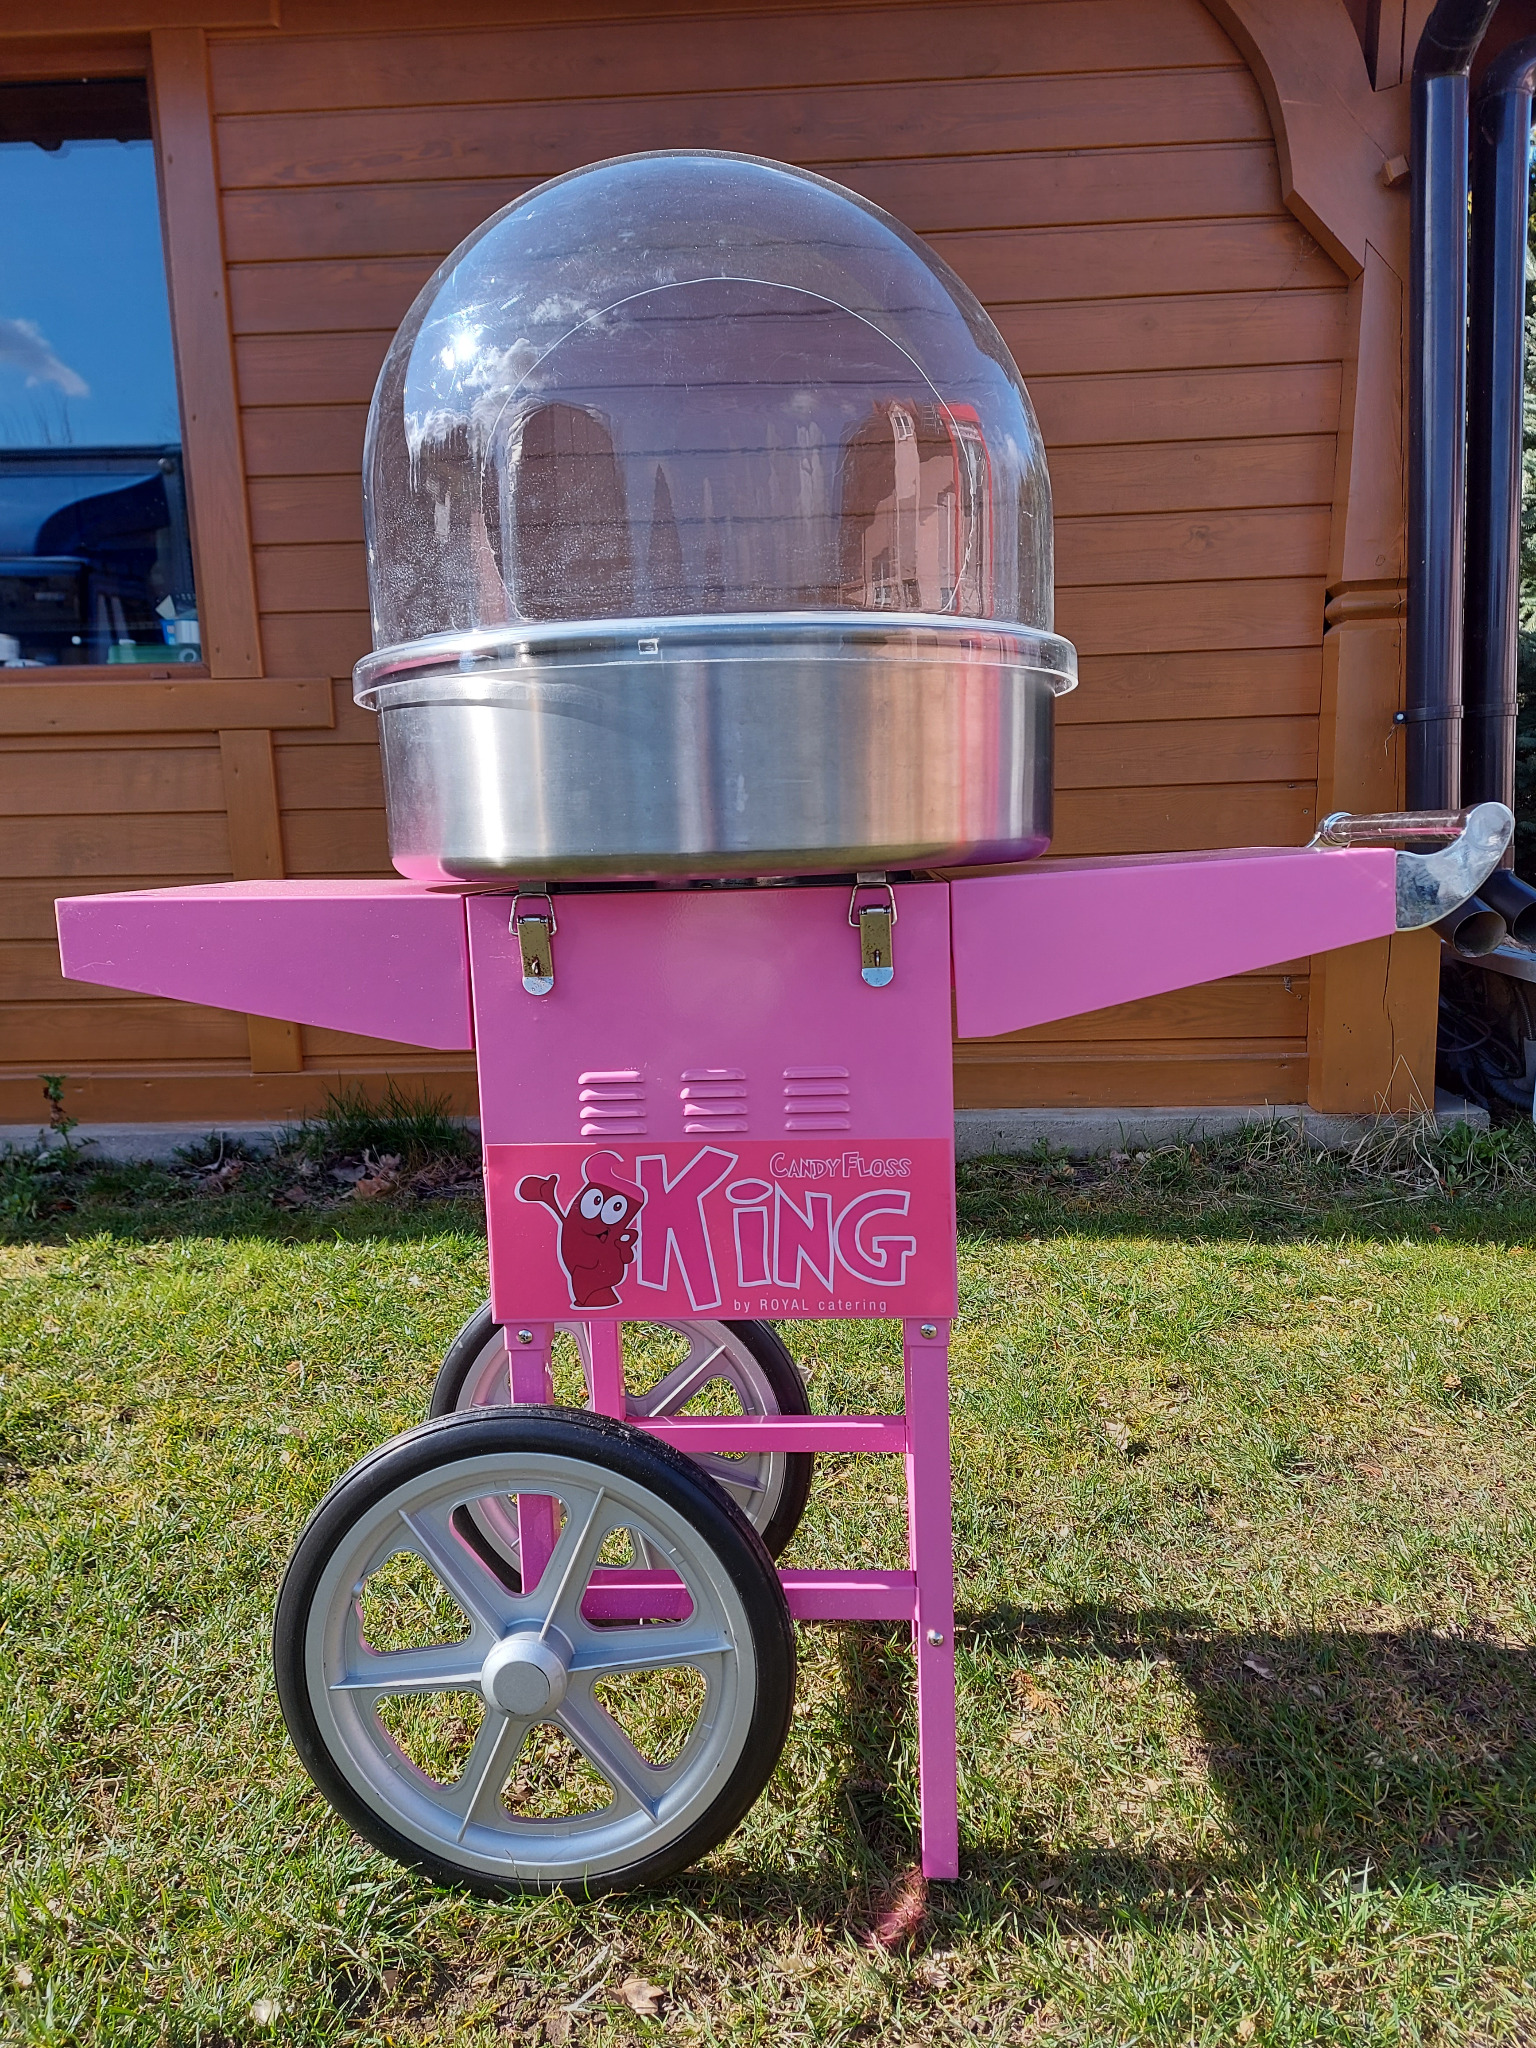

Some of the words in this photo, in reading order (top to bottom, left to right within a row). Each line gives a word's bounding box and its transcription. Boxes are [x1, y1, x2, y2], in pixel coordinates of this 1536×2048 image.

[733, 1299, 750, 1312] by
[759, 1298, 809, 1311] ROYAL
[818, 1299, 887, 1313] catering
